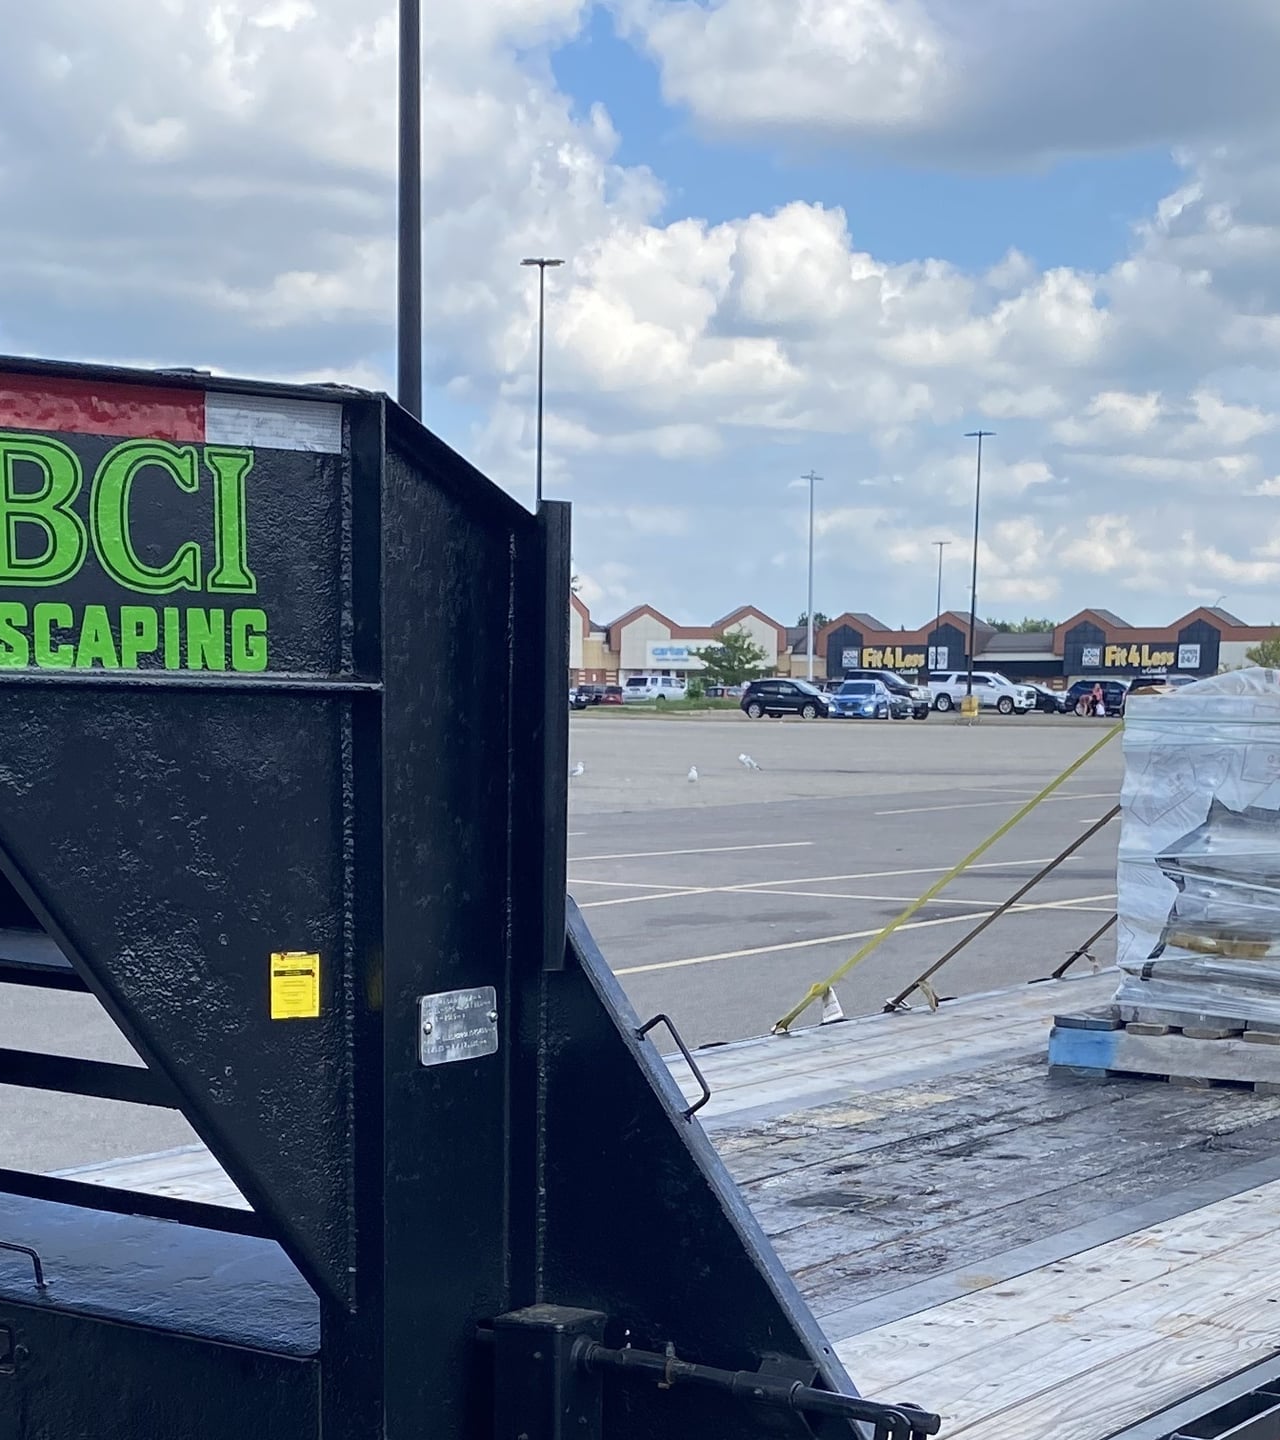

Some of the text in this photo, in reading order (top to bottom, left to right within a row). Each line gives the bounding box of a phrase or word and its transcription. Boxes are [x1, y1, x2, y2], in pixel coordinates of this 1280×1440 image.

[862, 647, 883, 669] Fit
[883, 647, 894, 669] 4
[1104, 645, 1128, 667] Fit
[1128, 645, 1141, 667] 4
